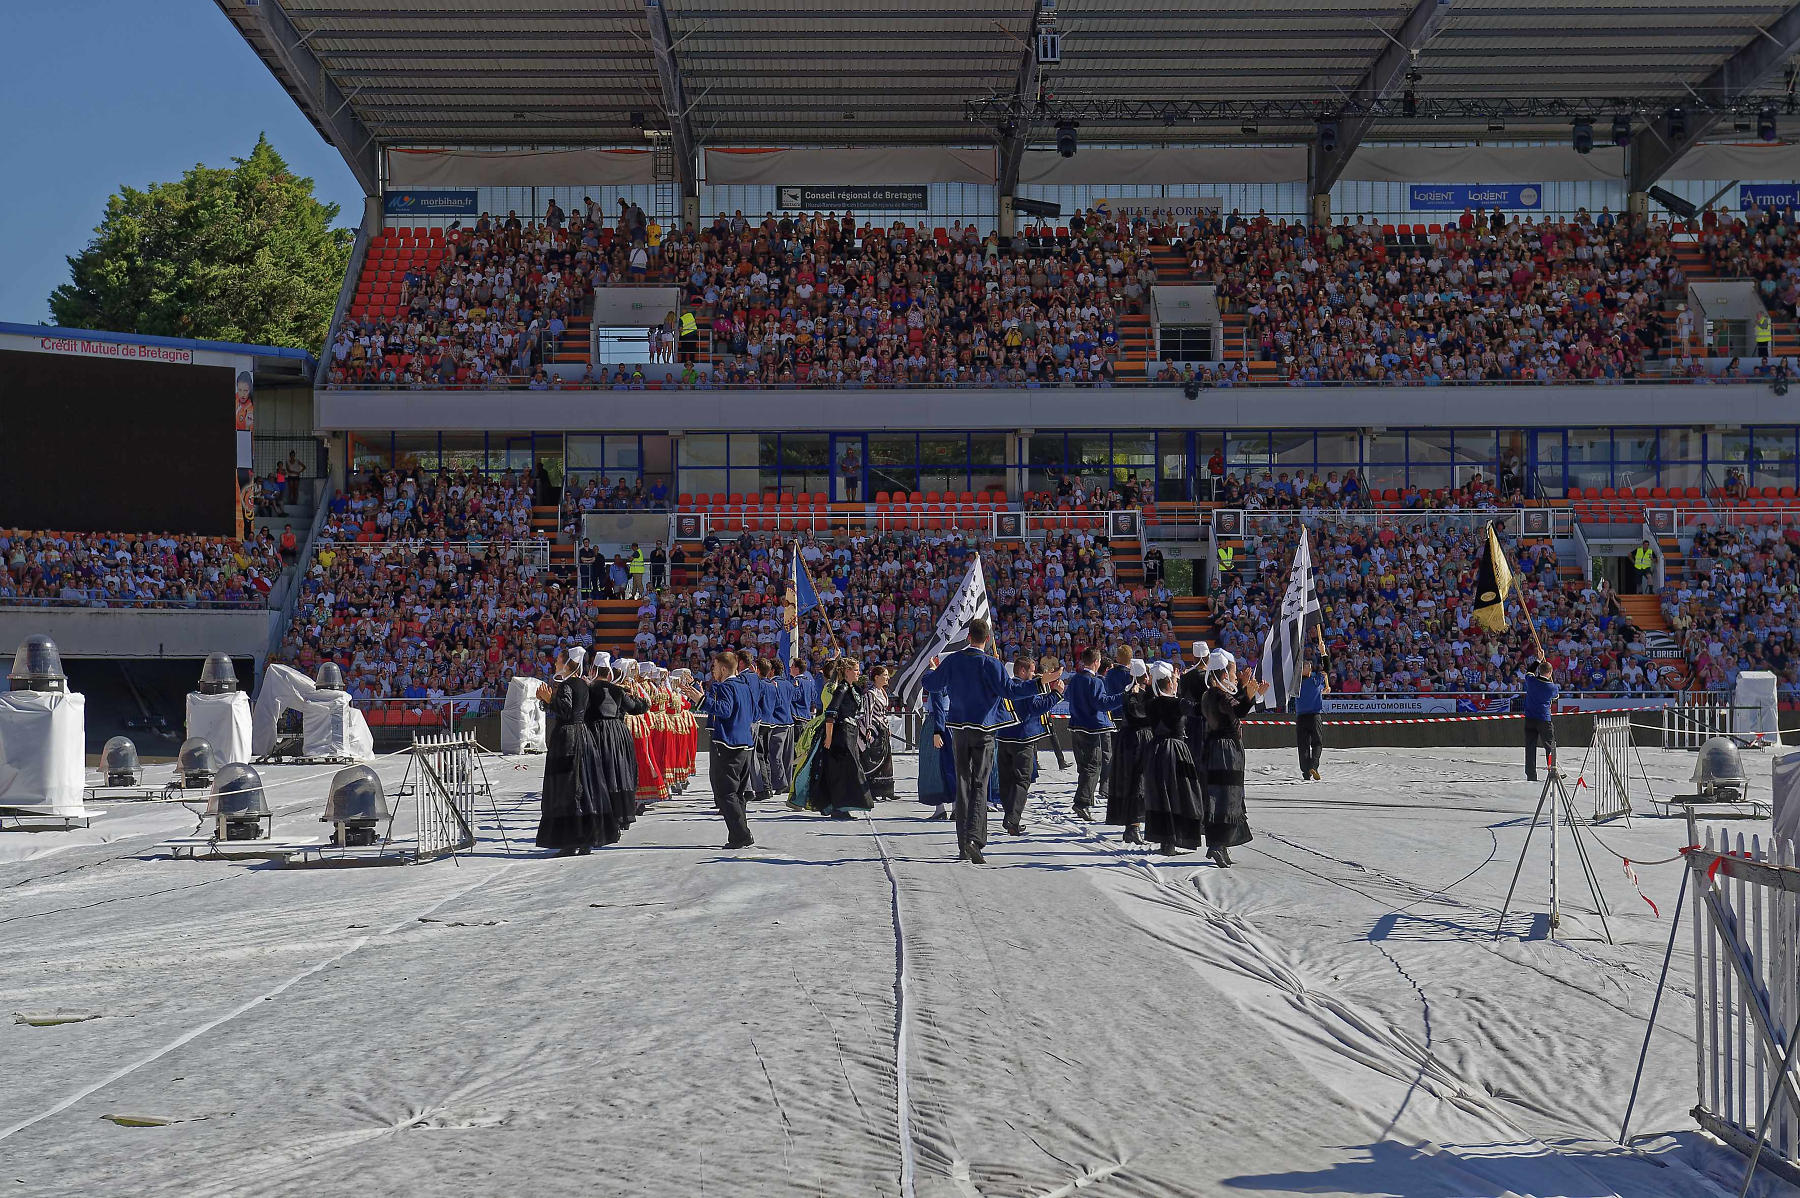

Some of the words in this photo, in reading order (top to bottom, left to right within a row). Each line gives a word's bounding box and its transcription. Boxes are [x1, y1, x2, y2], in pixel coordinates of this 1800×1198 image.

[805, 191, 835, 200] Conseil
[837, 190, 871, 201] régional
[873, 191, 883, 200] de
[885, 191, 922, 201] Bretagne
[1414, 190, 1455, 201] LORIENT
[1468, 190, 1509, 201] LORIENT
[420, 197, 473, 207] morbihan.fr
[42, 338, 78, 352] Crédit
[81, 341, 118, 356] Mutuel
[121, 345, 136, 357] de
[138, 347, 190, 362] Bretagne
[1653, 650, 1683, 658] LORIENT
[1365, 702, 1422, 710] AUTOMOBILES
